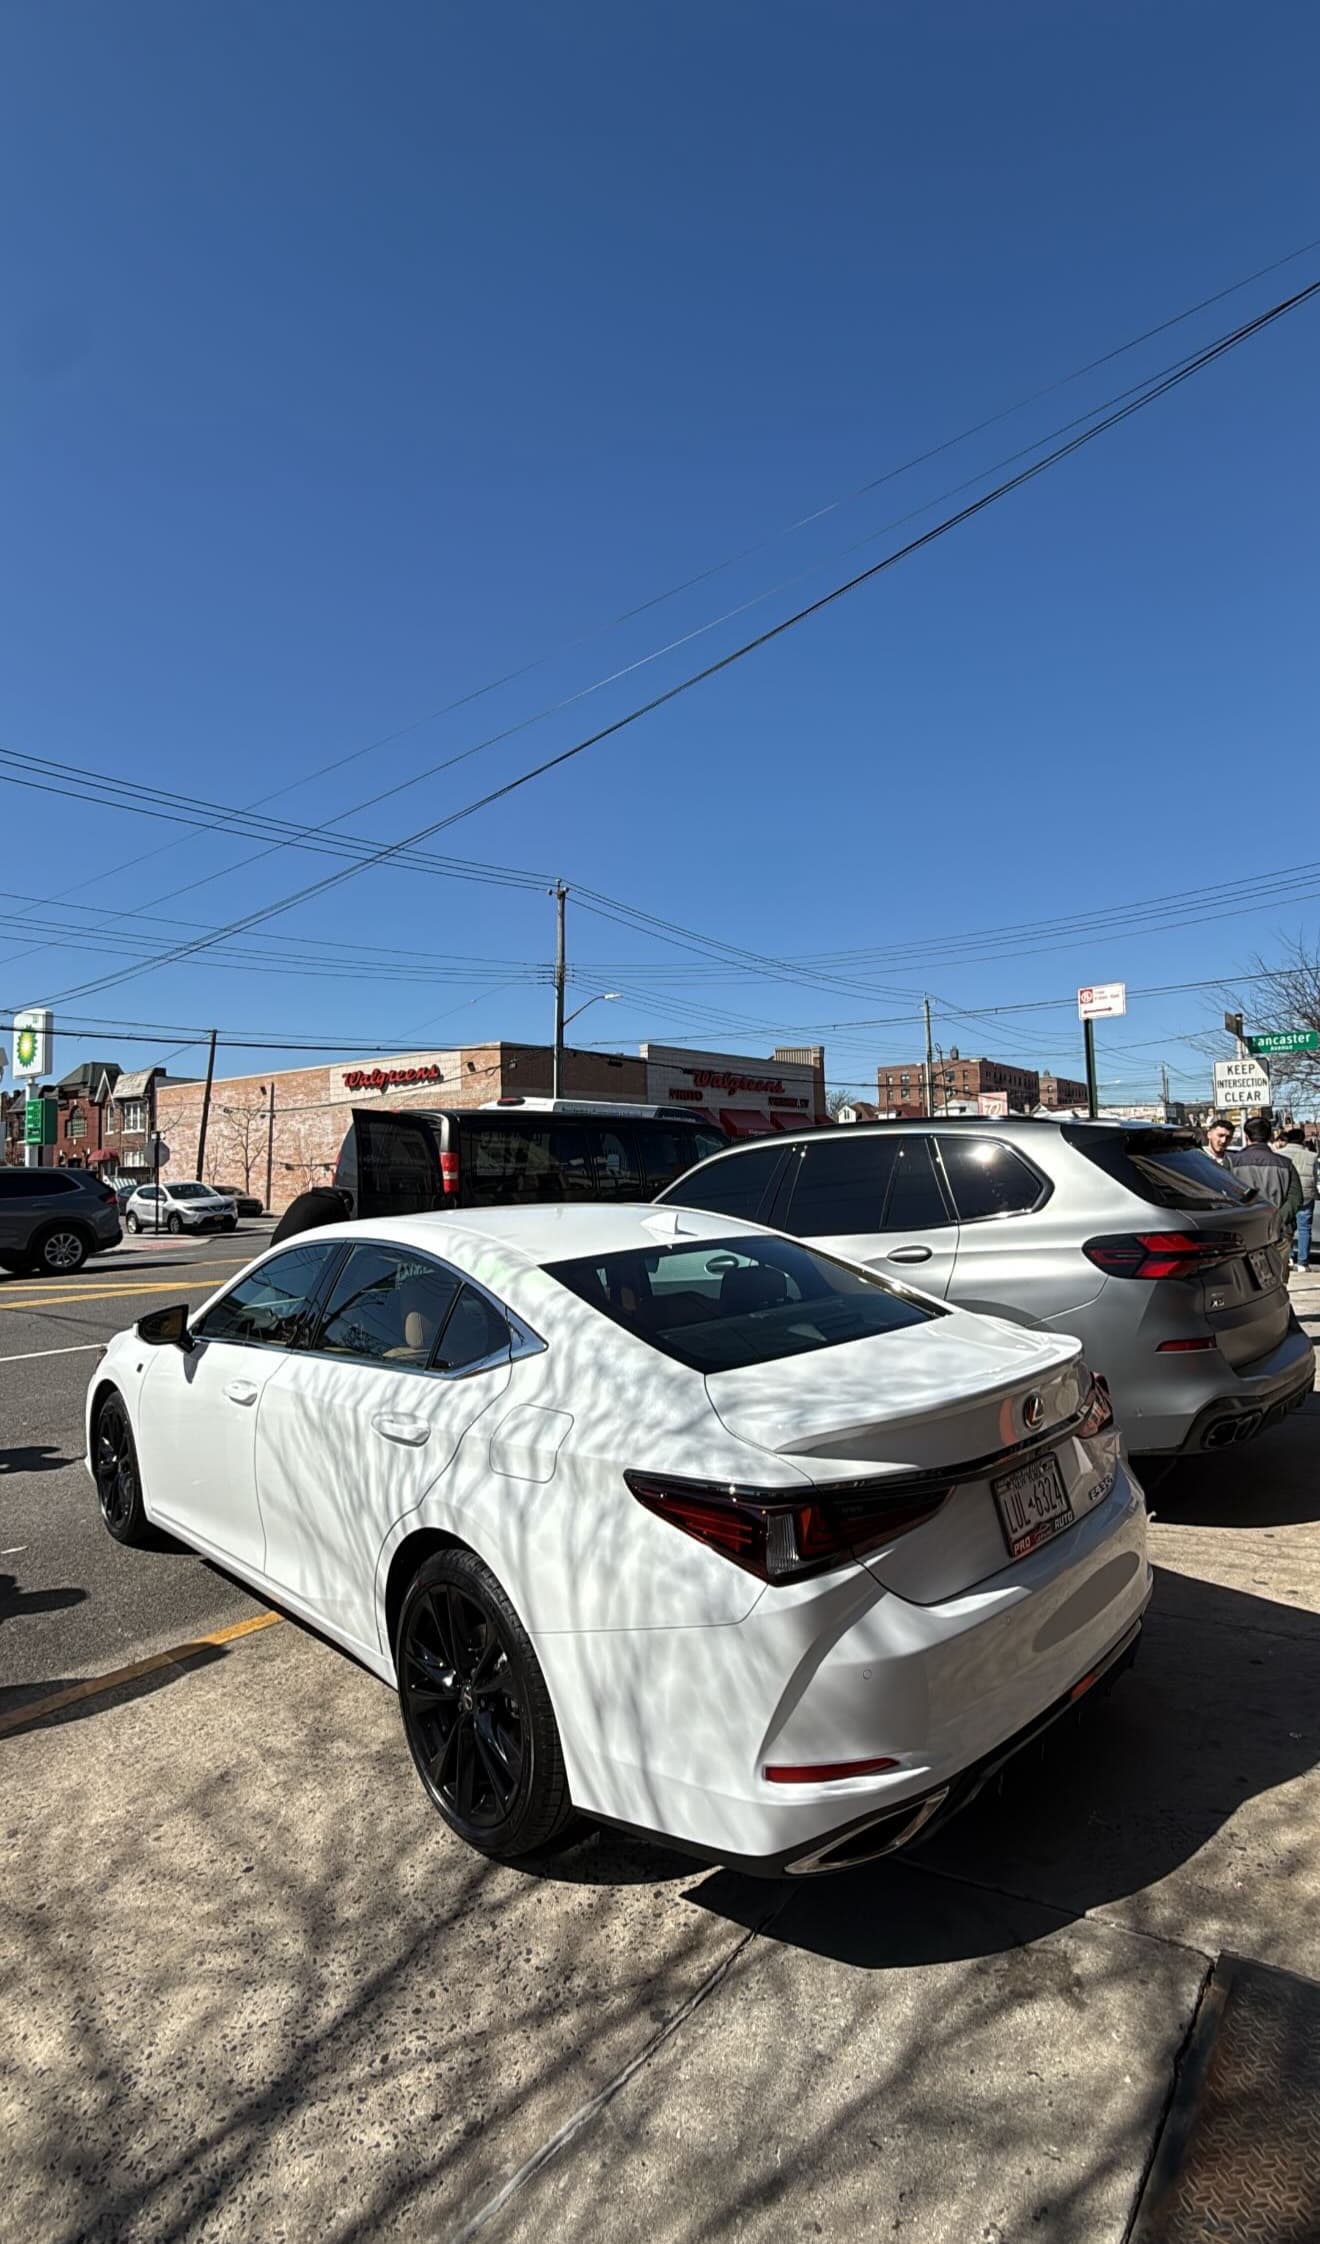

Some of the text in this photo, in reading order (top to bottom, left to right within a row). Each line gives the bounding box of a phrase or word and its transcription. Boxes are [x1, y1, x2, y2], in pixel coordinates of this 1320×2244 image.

[342, 1064, 441, 1090] Walgreens
[1227, 1064, 1255, 1075] KEEP
[693, 1070, 785, 1096] Walgreens
[1217, 1077, 1268, 1089] INTERSECTION
[1225, 1091, 1261, 1103] CLEAR
[1014, 1511, 1073, 1555] PRO AUTO
